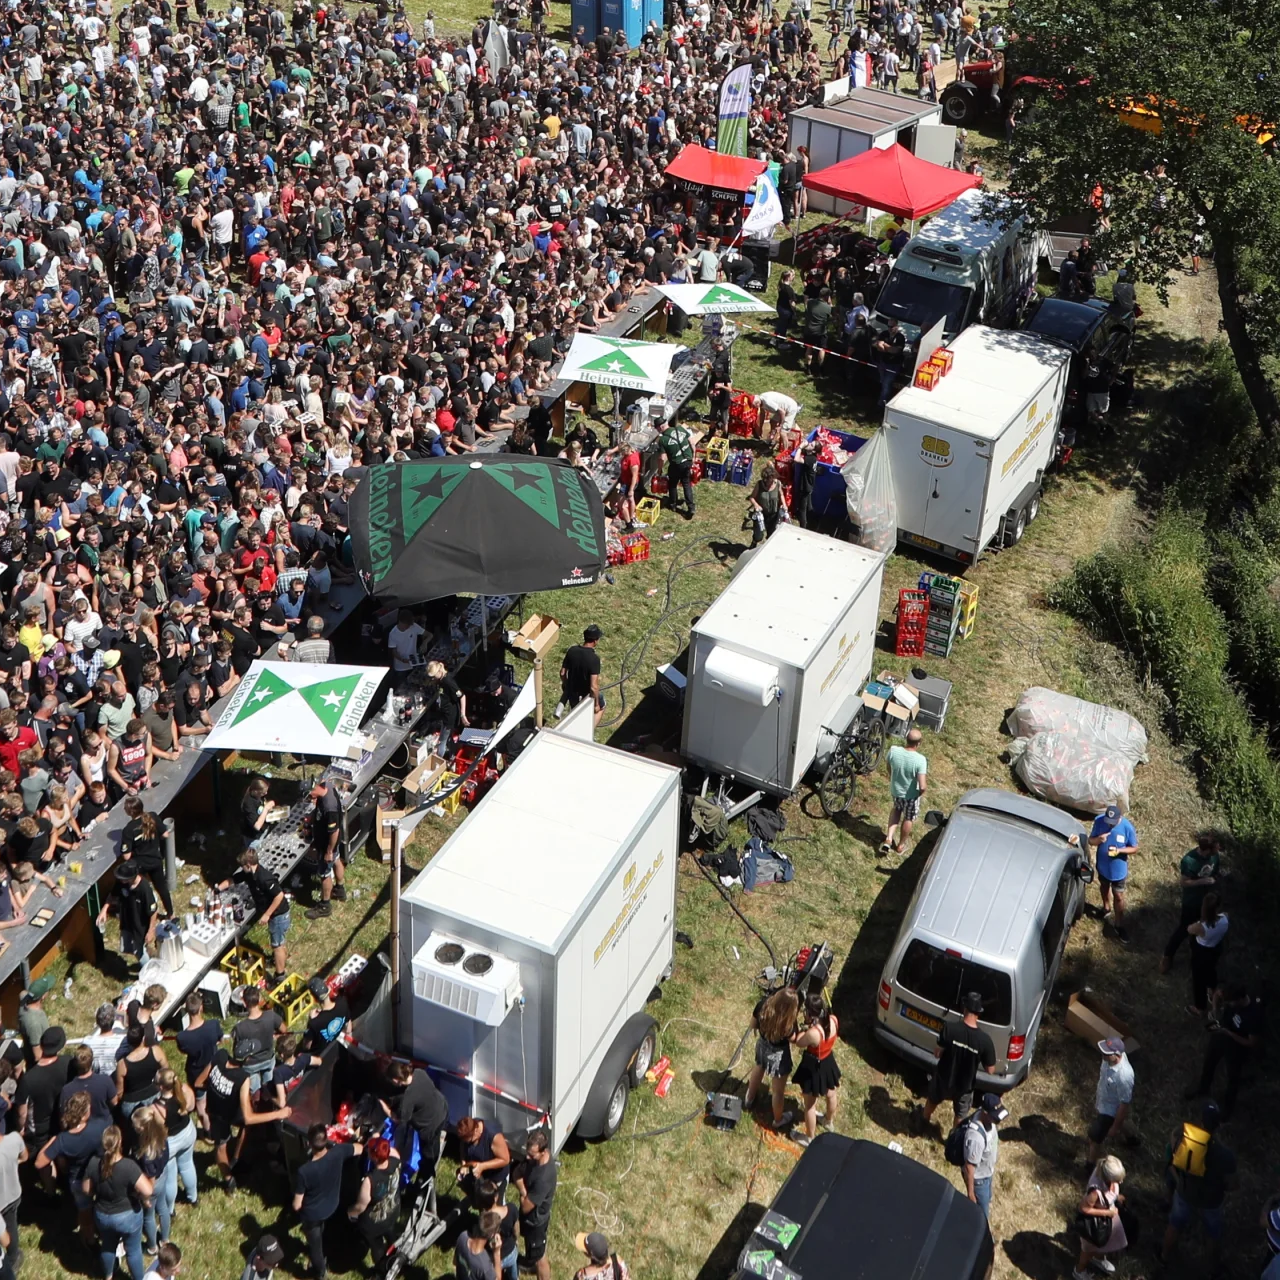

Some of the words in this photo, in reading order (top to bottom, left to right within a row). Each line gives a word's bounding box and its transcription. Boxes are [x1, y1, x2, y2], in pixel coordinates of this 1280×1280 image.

[702, 303, 758, 314] Heineken
[579, 371, 645, 390] Heineken
[920, 450, 949, 463] DRANKEN
[561, 576, 593, 586] Heineken
[216, 672, 259, 728] Heineken
[337, 680, 378, 738] Heineken
[122, 748, 146, 763] 1990
